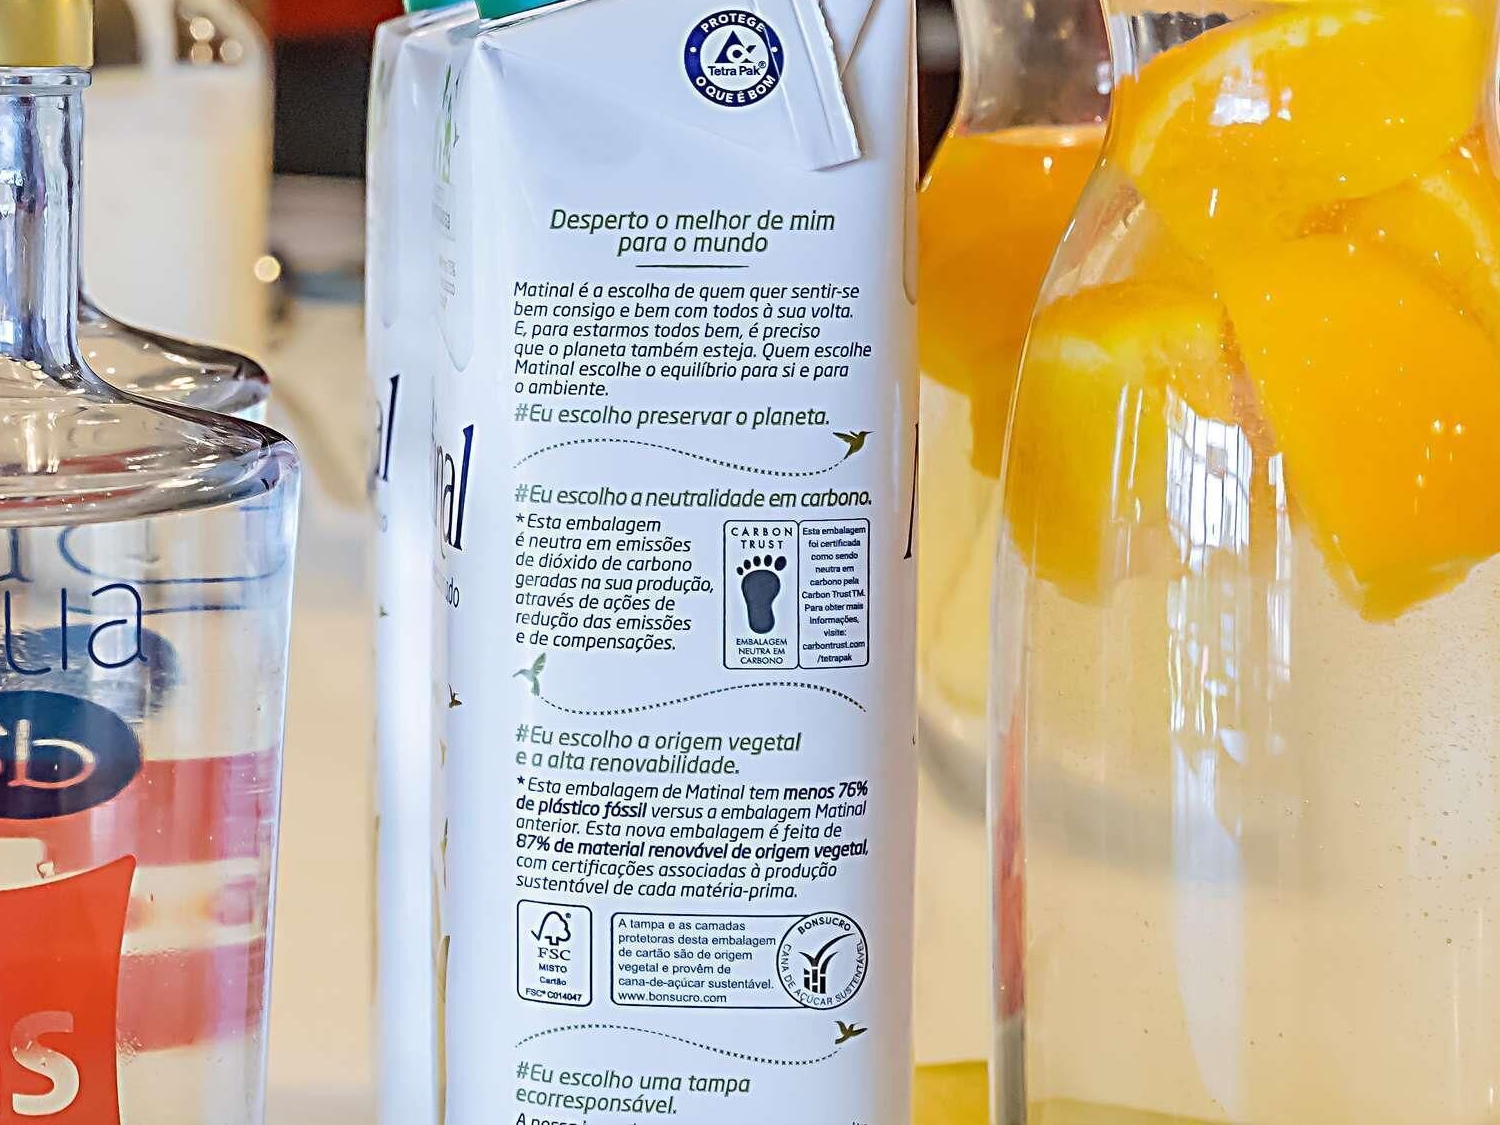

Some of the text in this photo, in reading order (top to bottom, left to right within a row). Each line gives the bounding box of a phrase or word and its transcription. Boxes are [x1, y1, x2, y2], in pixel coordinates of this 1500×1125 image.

[700, 13, 765, 33] PROTEGE
[707, 65, 737, 76] Tetra
[695, 74, 776, 103] O QUE É BOM
[549, 208, 835, 235] Desperto o melhor de mim
[616, 231, 768, 257] para o mundo
[513, 281, 860, 302] Matinal é a escolha de quem quer sentir-se
[513, 300, 853, 321] bem consigo e bem com todos à sua volta.
[514, 340, 872, 361] que o planeta também esteja. Quem escolhe
[514, 379, 608, 397] o ambiente.
[514, 402, 830, 430] #Eu escolho preservar o planeta.
[514, 483, 872, 508] #Eu escolho a neutralidade em carbono.
[565, 515, 661, 535] embalagem
[731, 527, 793, 536] CARBON
[802, 526, 866, 537] Esta embalagem
[515, 531, 692, 553] é neutra em emissões
[740, 540, 784, 549] TRUST
[820, 539, 861, 548] certificada
[515, 551, 692, 572] de dióxido de carbono
[514, 572, 714, 595] geradas na sua produção,
[515, 591, 675, 613] através de ações de
[802, 591, 831, 599] Carbon
[515, 610, 692, 631] redução das emissões
[515, 629, 676, 653] e de compensações.
[736, 638, 788, 646] EMBALAGEM
[802, 641, 866, 651] carbontrust.com
[740, 657, 784, 665] CARBONO
[817, 653, 853, 664] /tetrapak
[515, 723, 802, 755] #Eu escolho a origem vegetal
[565, 780, 659, 800] embalagem
[662, 783, 682, 799] de
[685, 783, 746, 800] Matinal
[748, 785, 780, 800] tem
[783, 784, 836, 801] menos
[837, 780, 869, 798] 76%
[515, 794, 867, 823] de plástico fóssil versus a embalagem Matinal
[515, 832, 869, 863] 87% de material renovável de origem vegetal,
[516, 855, 837, 881] com certificações associadas à produção
[515, 874, 797, 902] sustentável de cada matéria-prima.
[617, 918, 746, 932] A tampa e as camadas
[797, 916, 851, 935] BONSUCRO
[618, 933, 777, 949] protetoras desta embalagem
[537, 947, 572, 961] FSC
[538, 963, 568, 973] MISTO
[618, 976, 774, 990] cana-de-açúcar sustentável.
[617, 991, 727, 1003] www.bonsucro.com
[516, 1060, 751, 1095] #Eu escolho uma tampa
[515, 1087, 677, 1115] ecorresponsável.
